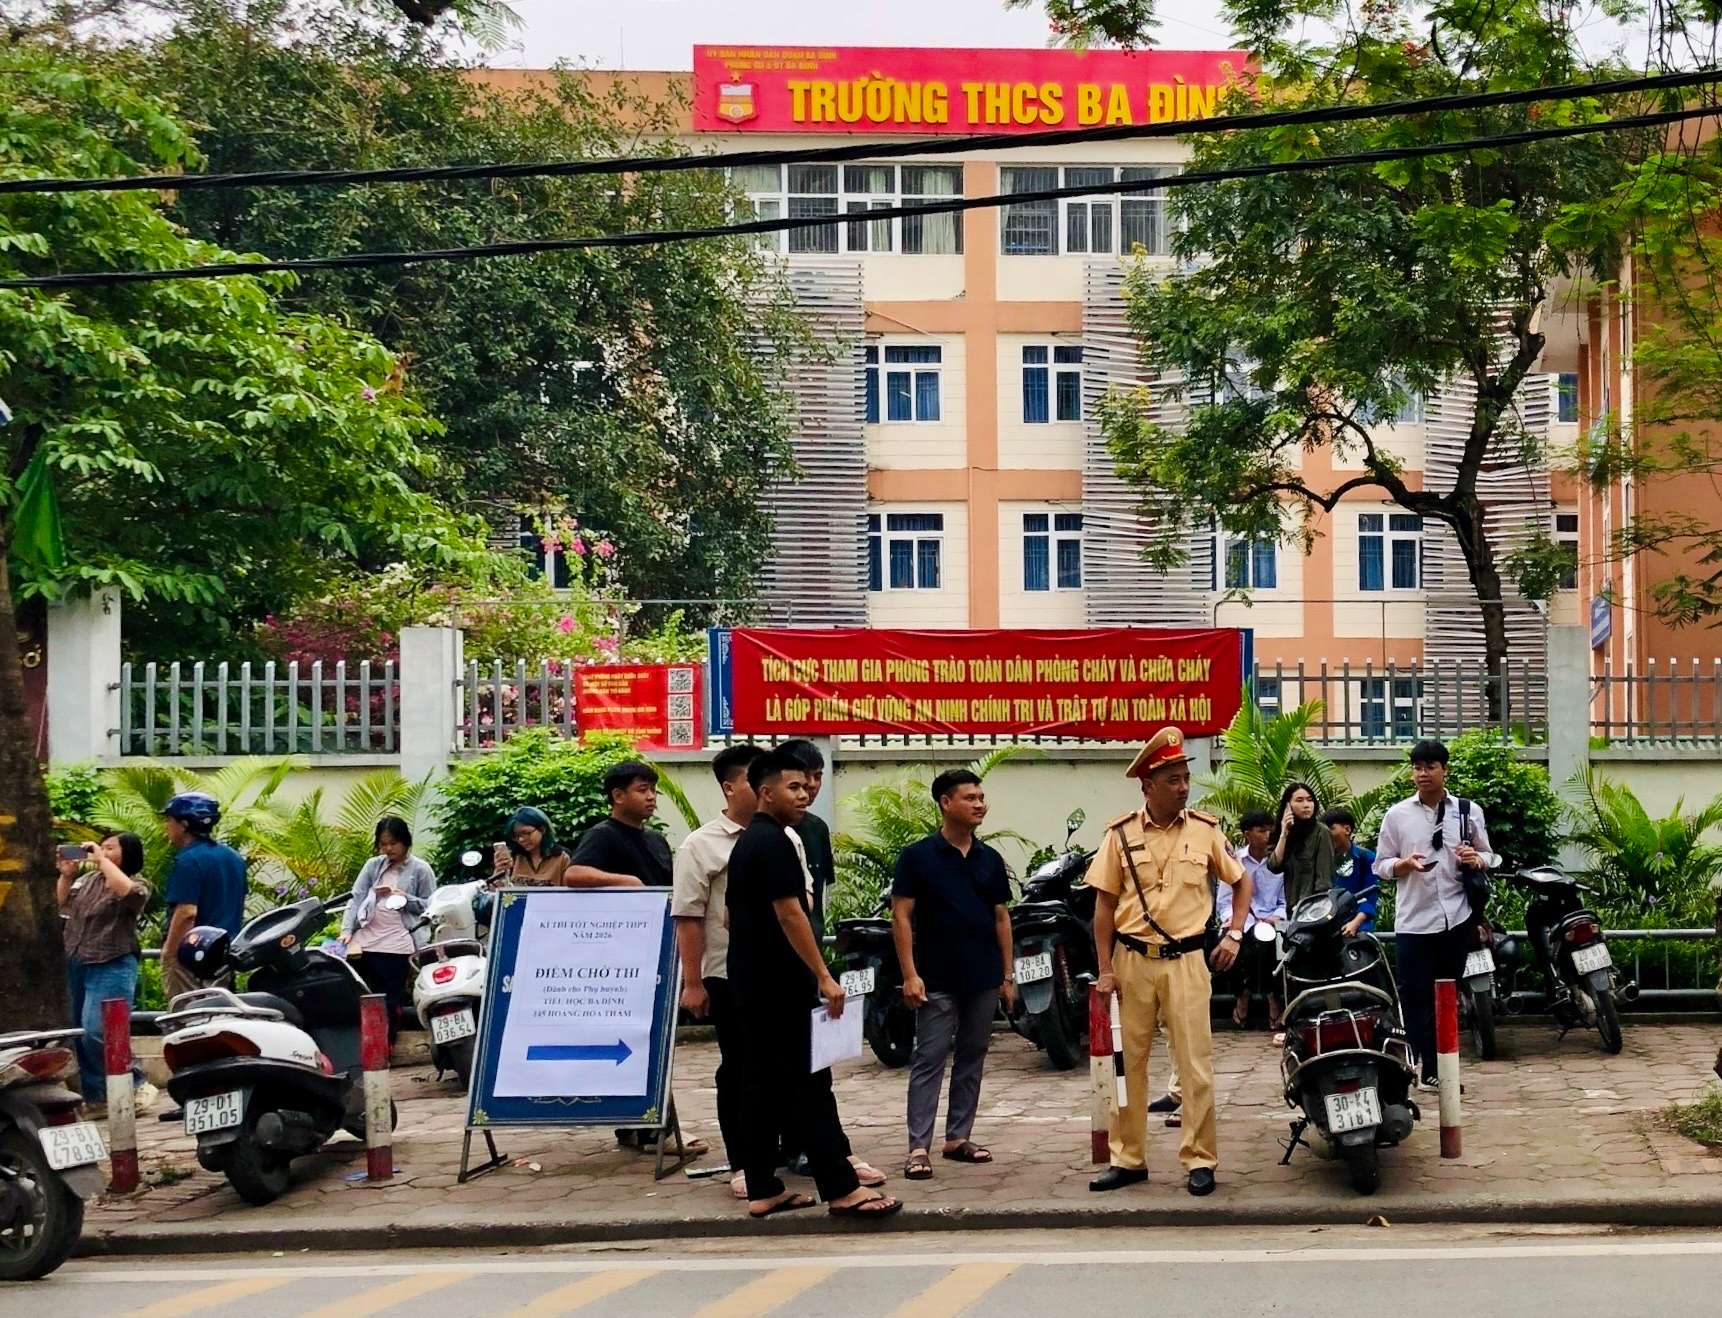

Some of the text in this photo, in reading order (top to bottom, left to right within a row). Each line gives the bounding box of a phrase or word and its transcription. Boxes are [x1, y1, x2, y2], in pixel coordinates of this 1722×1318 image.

[788, 71, 948, 124] TRƯỜNG
[962, 82, 1065, 125] THCS
[1077, 83, 1133, 125] BA
[762, 655, 790, 682] TÍCH
[793, 657, 819, 687] CỰC
[822, 659, 858, 682] THAM
[862, 659, 883, 682] GIA
[933, 654, 966, 683] TRÀO
[968, 654, 1003, 683] TOÀN
[1005, 654, 1033, 683] DÂN
[1036, 653, 1080, 682] PHÒNG
[1082, 654, 1117, 682] CHÁY
[1119, 653, 1137, 682] VÀ
[1140, 654, 1175, 682] CHỮA
[1178, 653, 1211, 682] CHÁY
[766, 690, 1212, 727] LÀ GÓP PHẦN GIỮ VỮNG AN NINH CHÍNH TRỊ VÀ TRẬT TỰ AN TOÀN XÃ HỘI
[552, 921, 567, 929] THI
[625, 921, 648, 929] THPT
[535, 964, 573, 979] ĐIỂM
[614, 967, 640, 979] THI
[193, 1094, 232, 1116] 29-D1
[189, 1108, 238, 1132] 351.05
[1336, 1107, 1374, 1129] 3181
